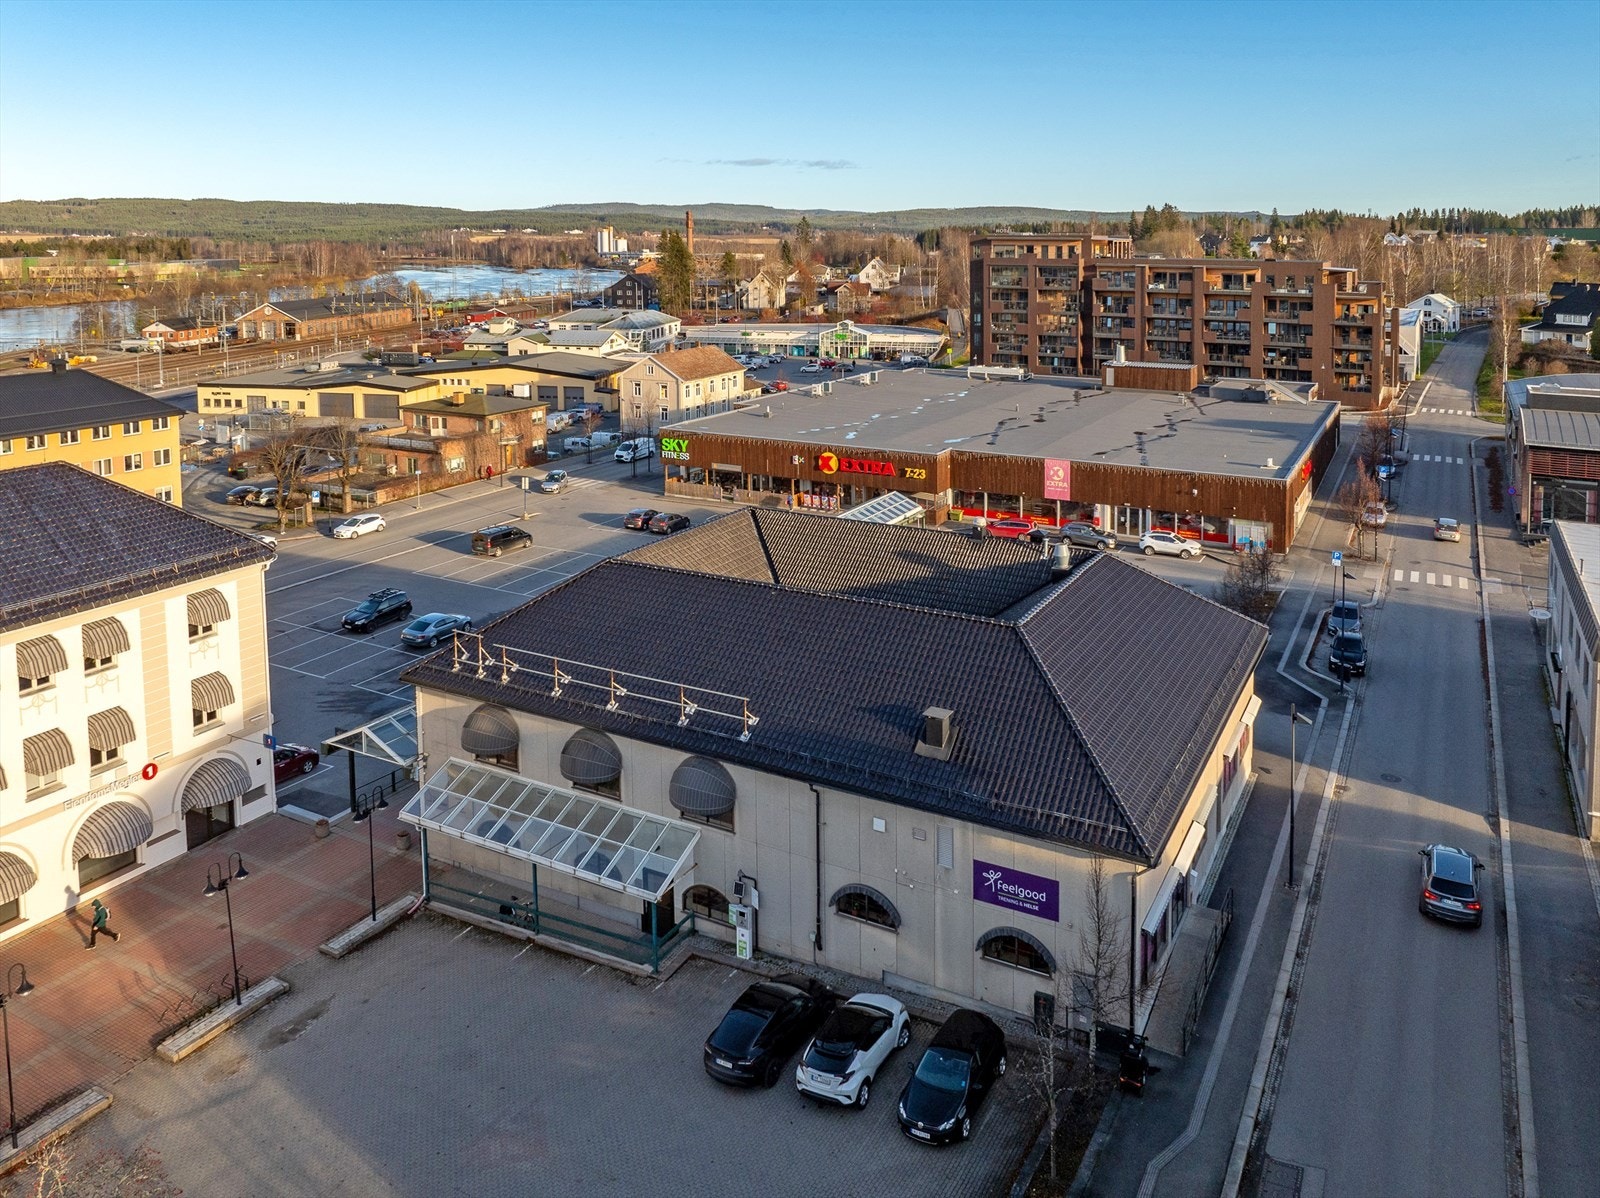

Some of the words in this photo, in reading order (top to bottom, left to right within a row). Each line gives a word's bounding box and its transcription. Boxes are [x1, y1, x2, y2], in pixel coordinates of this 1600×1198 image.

[662, 438, 689, 452] SKY
[662, 450, 690, 460] FITNESS
[840, 458, 896, 476] EXTRA
[905, 467, 926, 479] 7-23
[997, 880, 1046, 902] feelgood
[998, 895, 1018, 905] TRENING
[1023, 902, 1039, 911] HELSE
